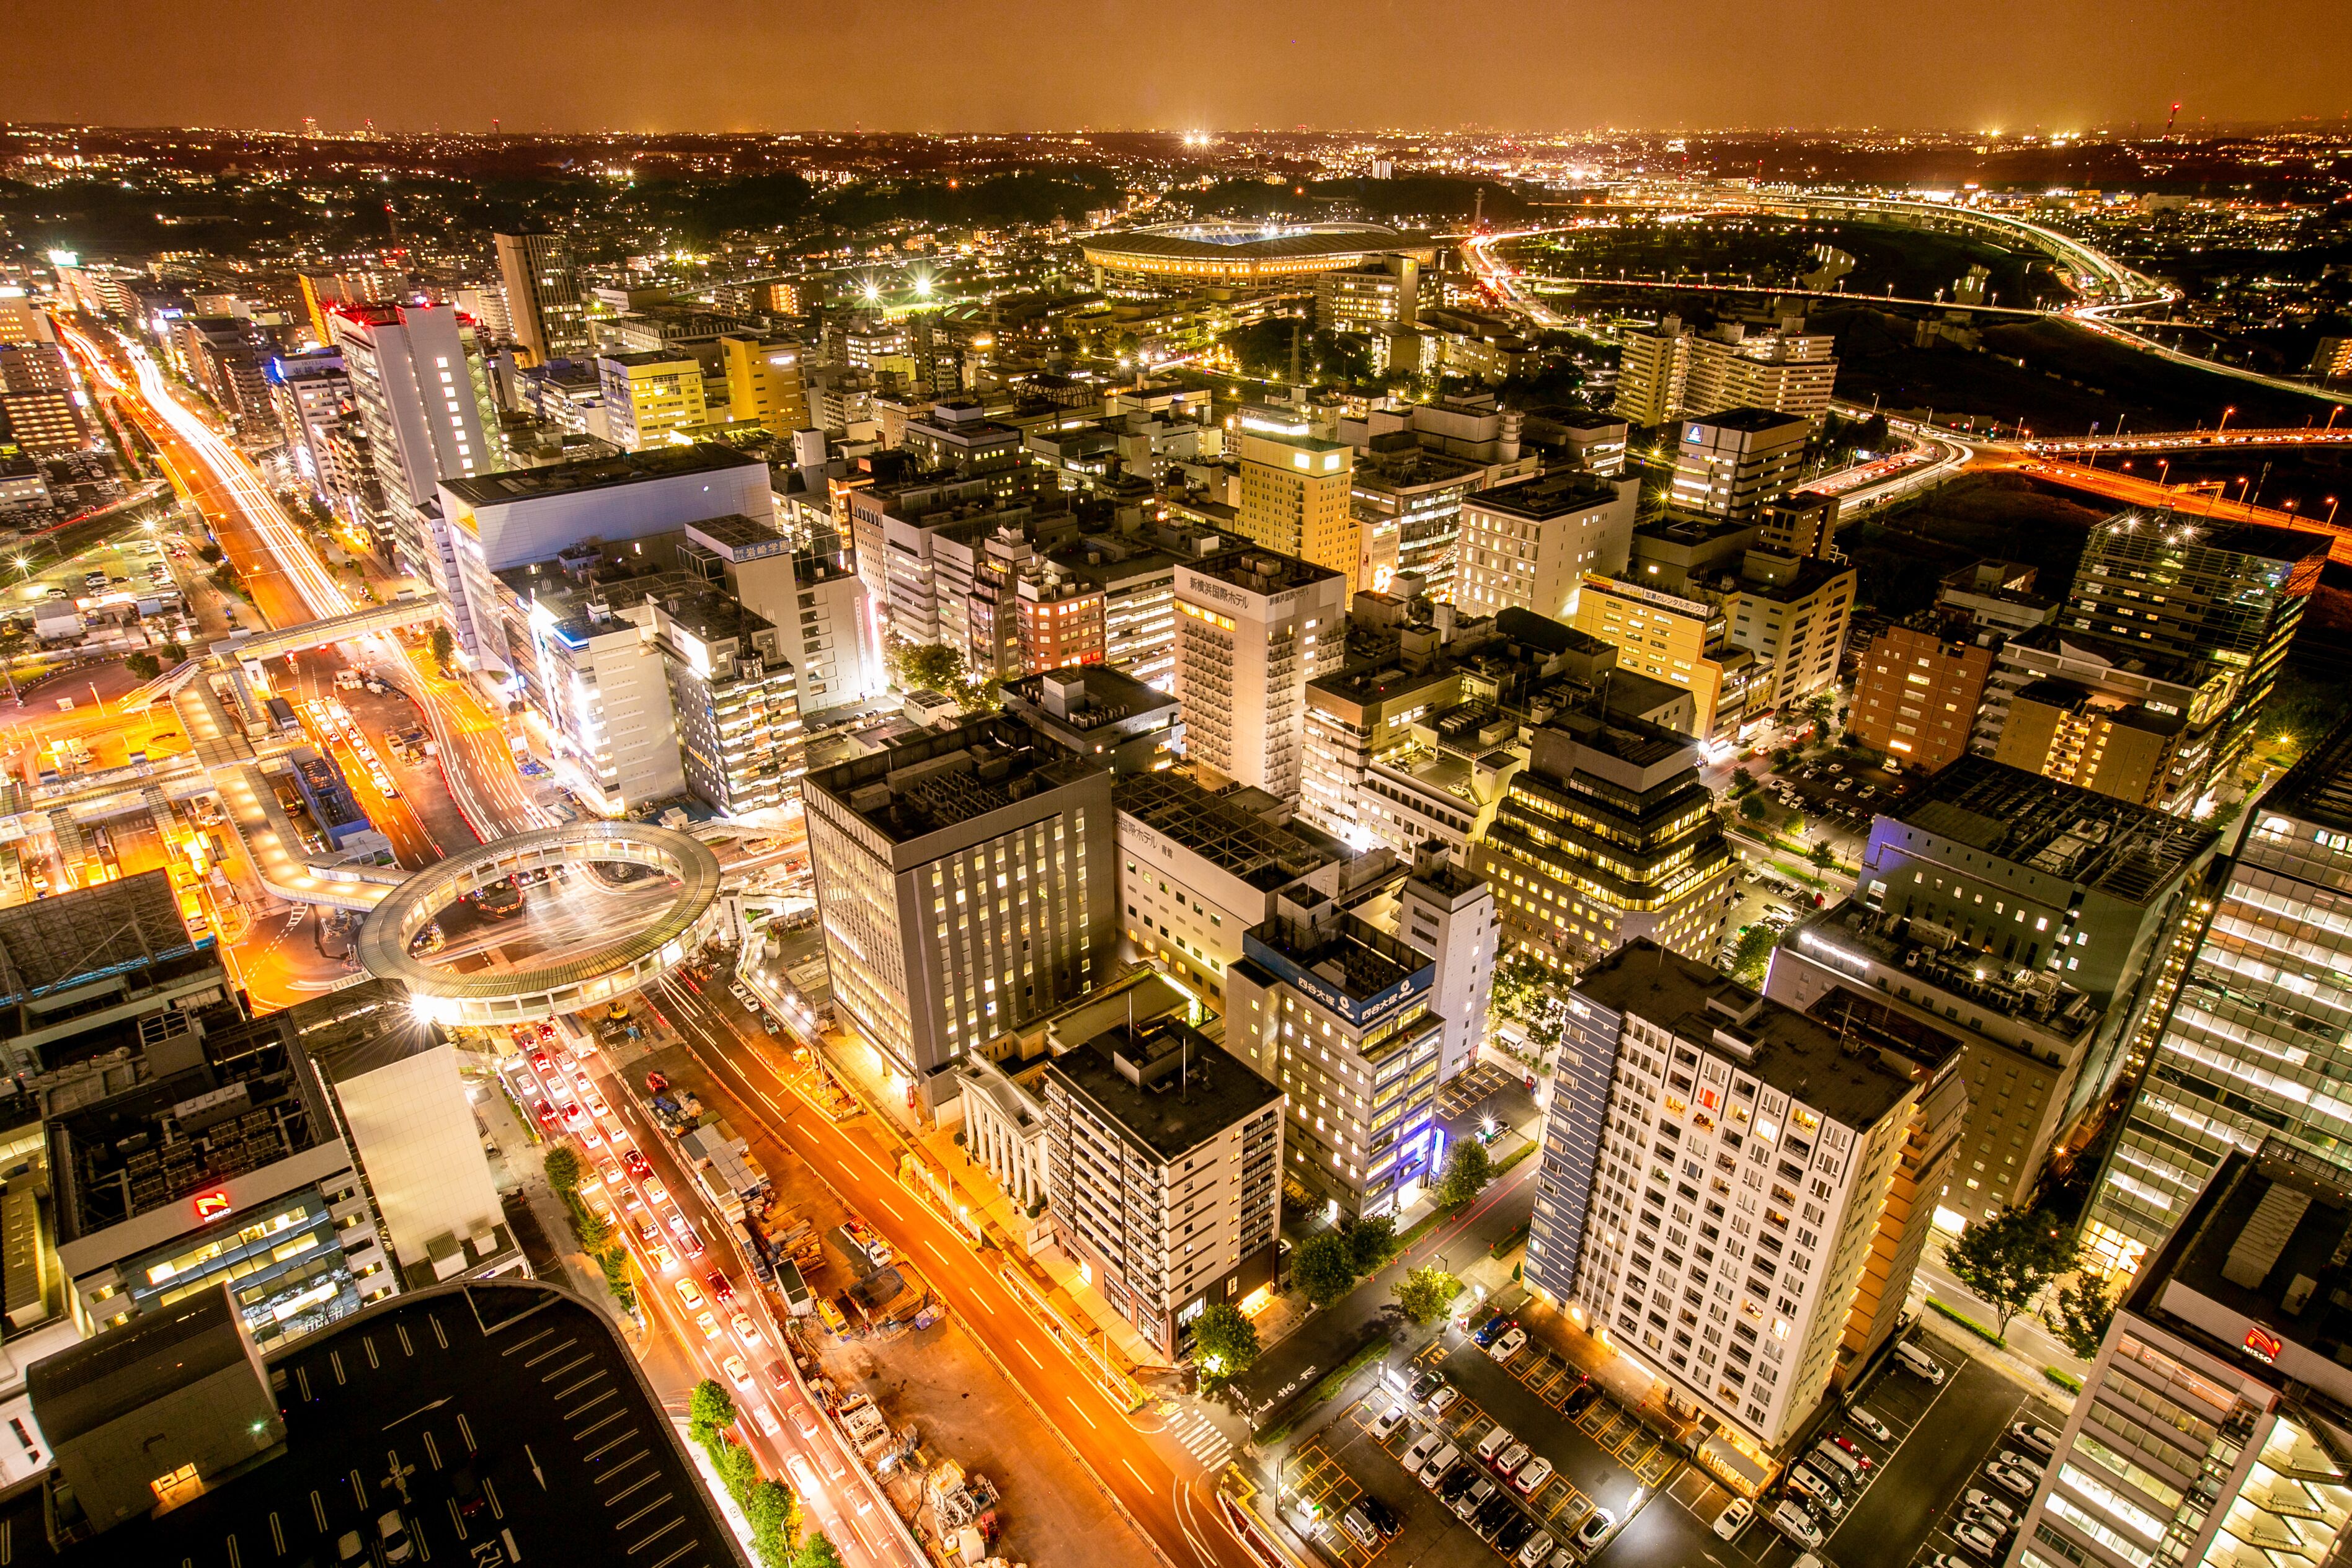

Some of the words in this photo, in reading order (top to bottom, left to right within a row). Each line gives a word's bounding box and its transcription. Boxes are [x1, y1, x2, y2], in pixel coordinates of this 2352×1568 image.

[746, 540, 790, 557] 岩崎学園
[1189, 577, 1249, 609] 新横浜国際ホテル
[1269, 587, 1310, 606] 新横浜国際ホテル
[1298, 977, 1335, 1007] 四谷大塚
[1362, 993, 1398, 1020] 四谷大塚
[2241, 1344, 2273, 1363] NISSO
